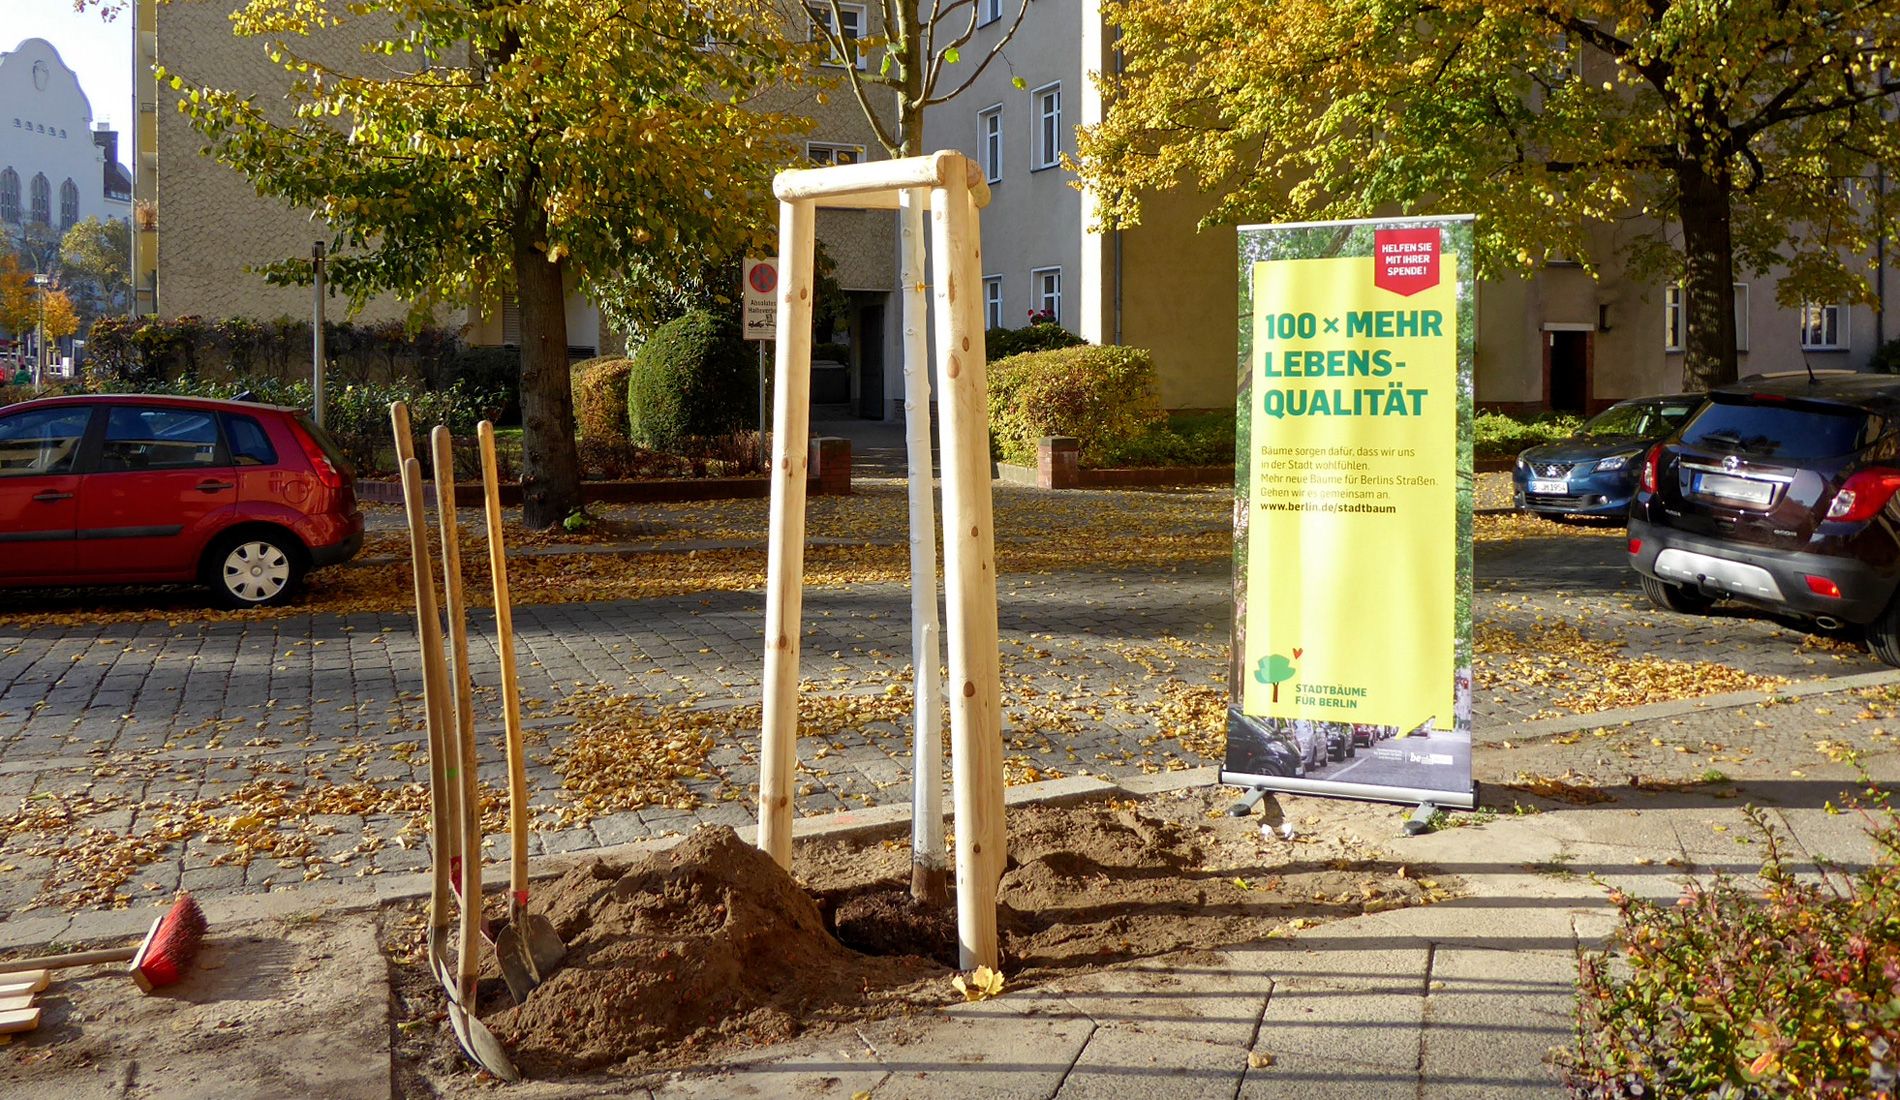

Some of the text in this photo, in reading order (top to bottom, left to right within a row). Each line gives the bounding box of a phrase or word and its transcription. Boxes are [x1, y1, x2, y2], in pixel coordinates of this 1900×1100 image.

[1381, 242, 1433, 253] HELFEN SIE
[1385, 254, 1431, 265] MIT IHRER
[1265, 312, 1317, 340] 100
[1346, 310, 1443, 338] MEHR
[1264, 350, 1406, 378] LEBENS-
[1264, 381, 1429, 420] QUALITÄT
[1261, 445, 1416, 458] Bäume sorgen dafür, dass wir uns
[1261, 459, 1370, 471] in der Stadt wohlfühlen.
[1260, 473, 1439, 486] Mehr neue Bäume für Berlins Straßen.
[1260, 487, 1391, 500] Gehen wir es gemeinsam an.
[1260, 501, 1397, 514] www.berlin.de/stadtbaum
[1295, 683, 1367, 698] STADTBÄUME
[1295, 695, 1358, 709] FÜR BERLIN
